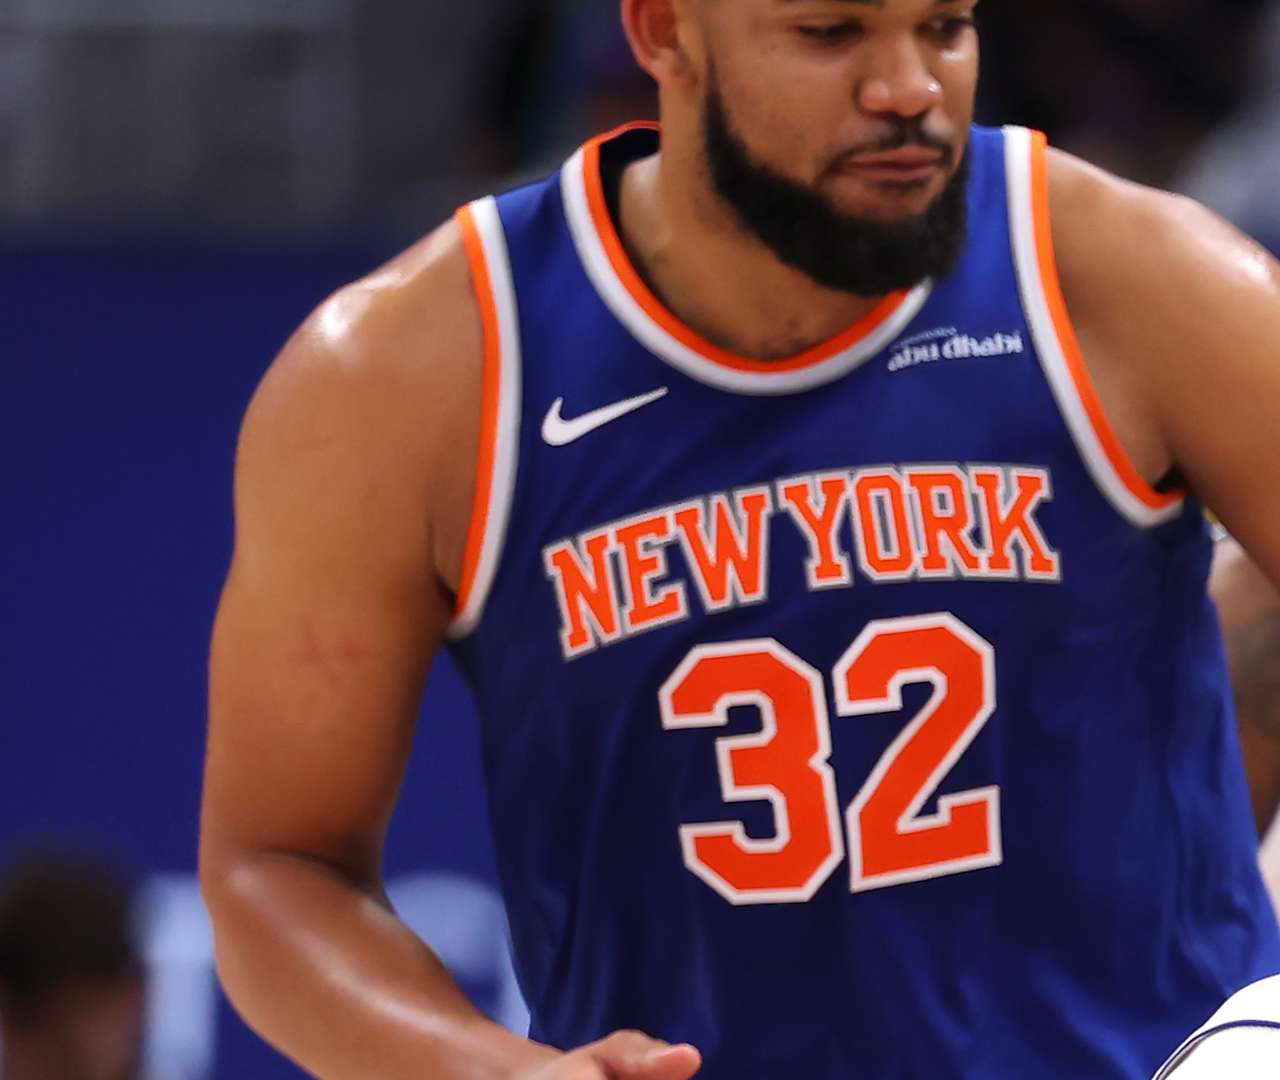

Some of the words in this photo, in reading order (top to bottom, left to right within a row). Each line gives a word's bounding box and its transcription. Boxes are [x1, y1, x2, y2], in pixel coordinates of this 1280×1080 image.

[543, 484, 772, 660] NEW
[776, 463, 1063, 591] YORK
[658, 611, 1003, 906] 32
